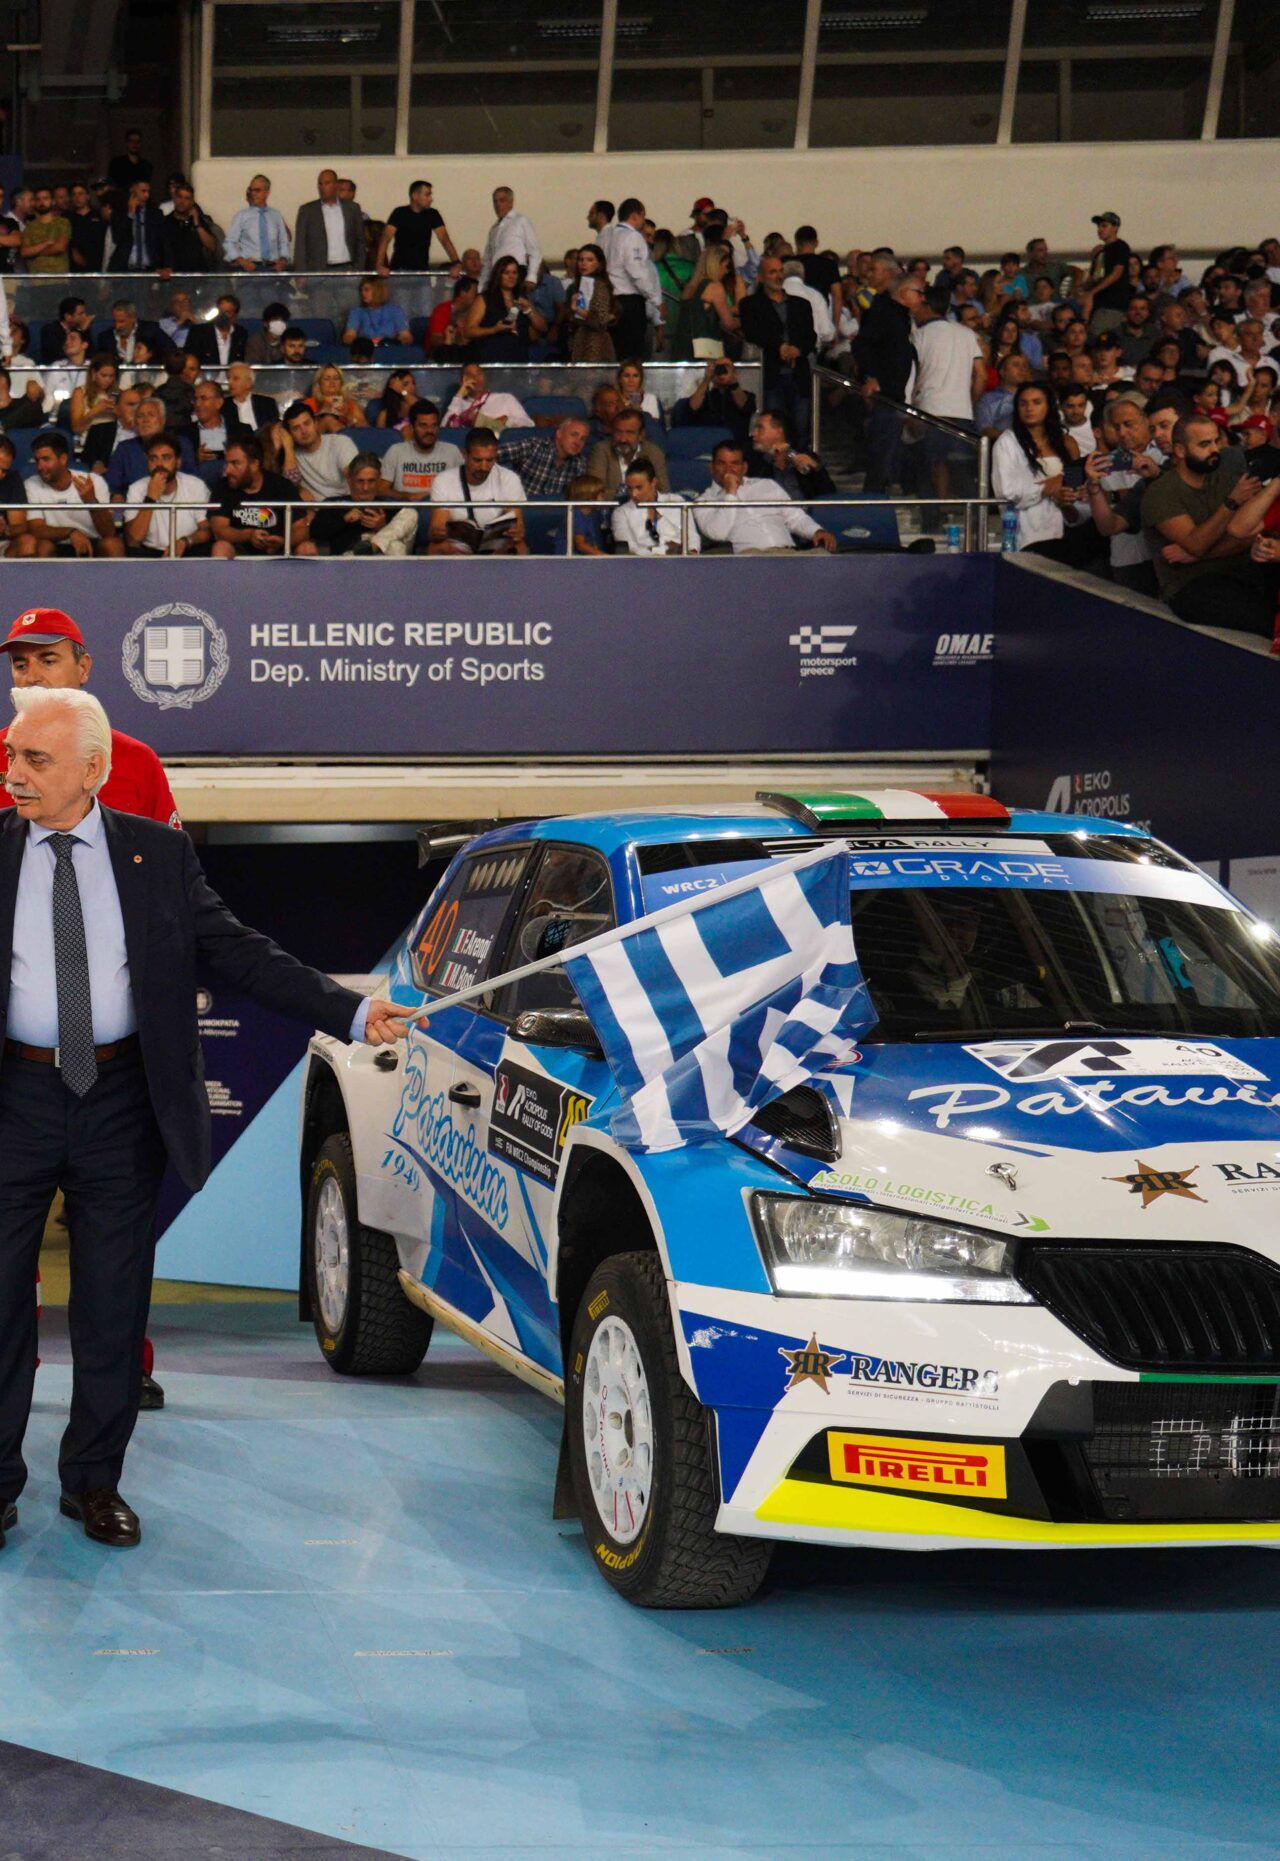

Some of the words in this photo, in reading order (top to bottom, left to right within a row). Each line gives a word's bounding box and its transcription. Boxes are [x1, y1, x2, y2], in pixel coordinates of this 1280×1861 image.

[250, 622, 395, 647] HELLENIC
[404, 622, 553, 647] REPUBLIC
[935, 633, 995, 655] OMAE
[250, 659, 310, 687] Dep.
[320, 657, 419, 687] Ministry
[428, 657, 454, 682] of
[460, 658, 545, 687] Sports
[800, 656, 857, 667] motorsport
[800, 667, 835, 677] greece
[1084, 770, 1112, 792] EKO
[912, 839, 996, 849] RALLY
[891, 858, 1070, 879] GRADE
[661, 878, 720, 895] WRC2
[940, 874, 1074, 886] DIGITAL
[419, 899, 460, 977] 40
[813, 1170, 879, 1190] ASOLO
[883, 1181, 994, 1215] LOGISTICA
[851, 1355, 1000, 1394] RANGERS
[843, 1443, 989, 1487] PIRELLI
